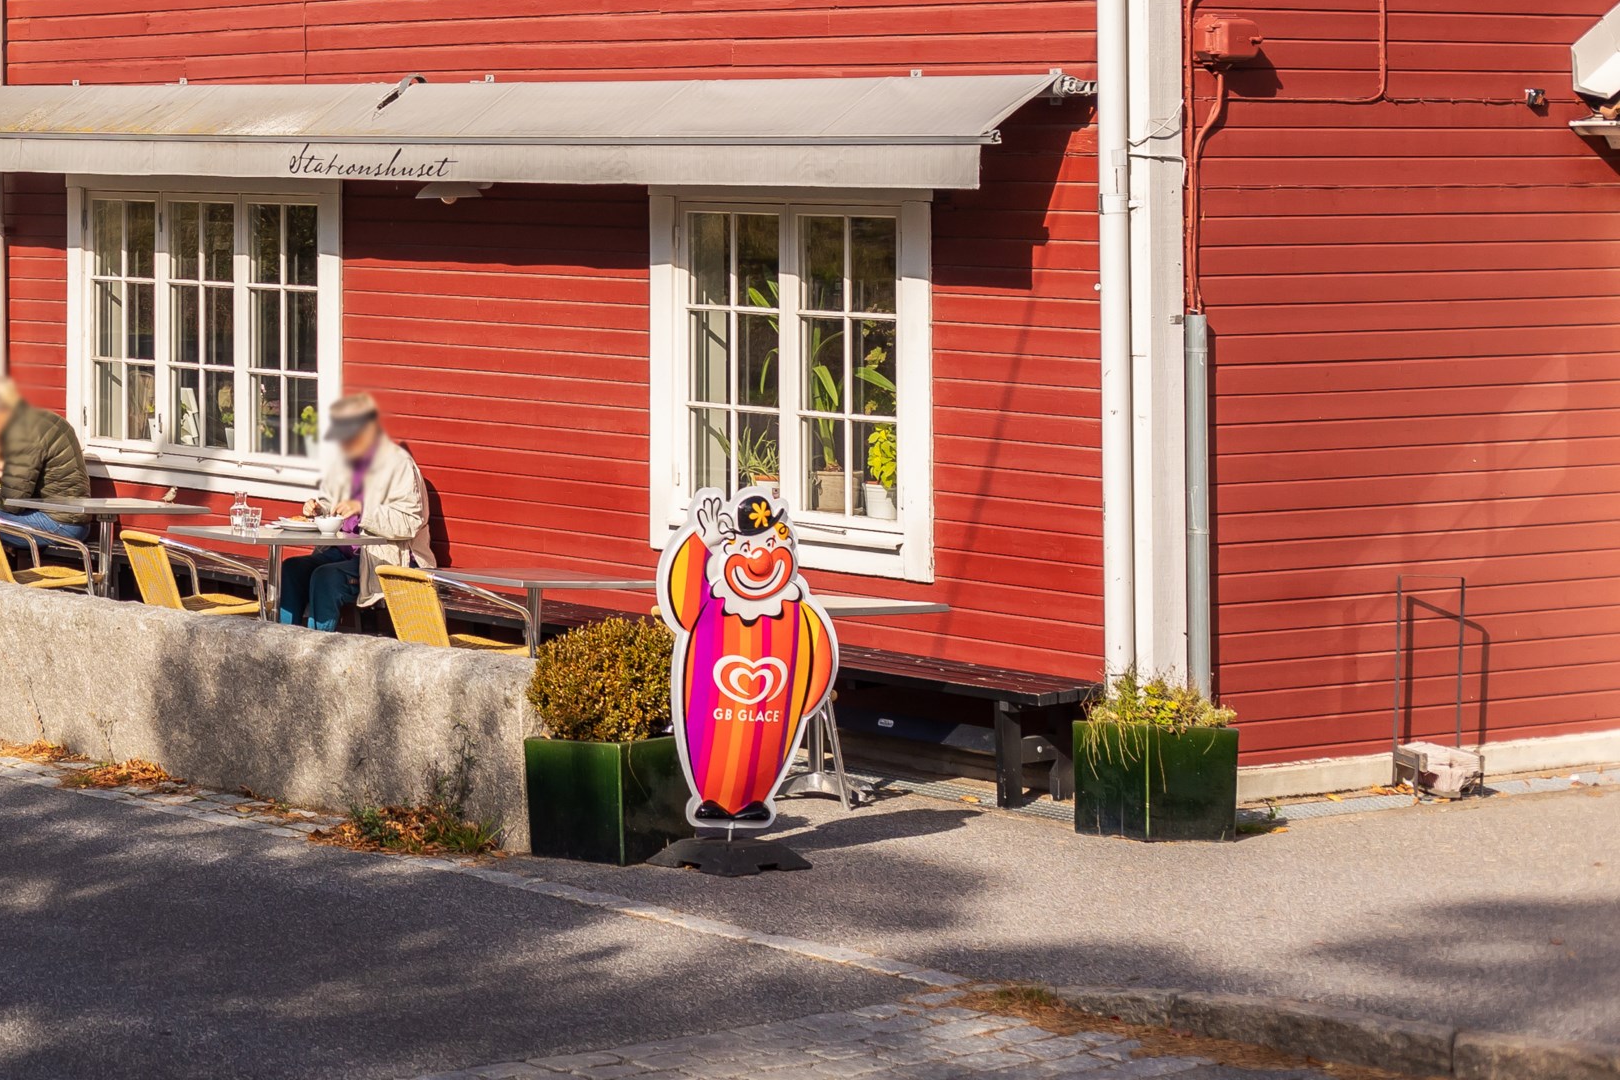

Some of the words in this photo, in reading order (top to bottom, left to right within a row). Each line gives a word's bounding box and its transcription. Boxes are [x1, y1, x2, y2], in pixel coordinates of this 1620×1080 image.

[289, 143, 459, 178] Stationshuset
[713, 707, 733, 721] GB
[737, 709, 780, 722] GLACE
